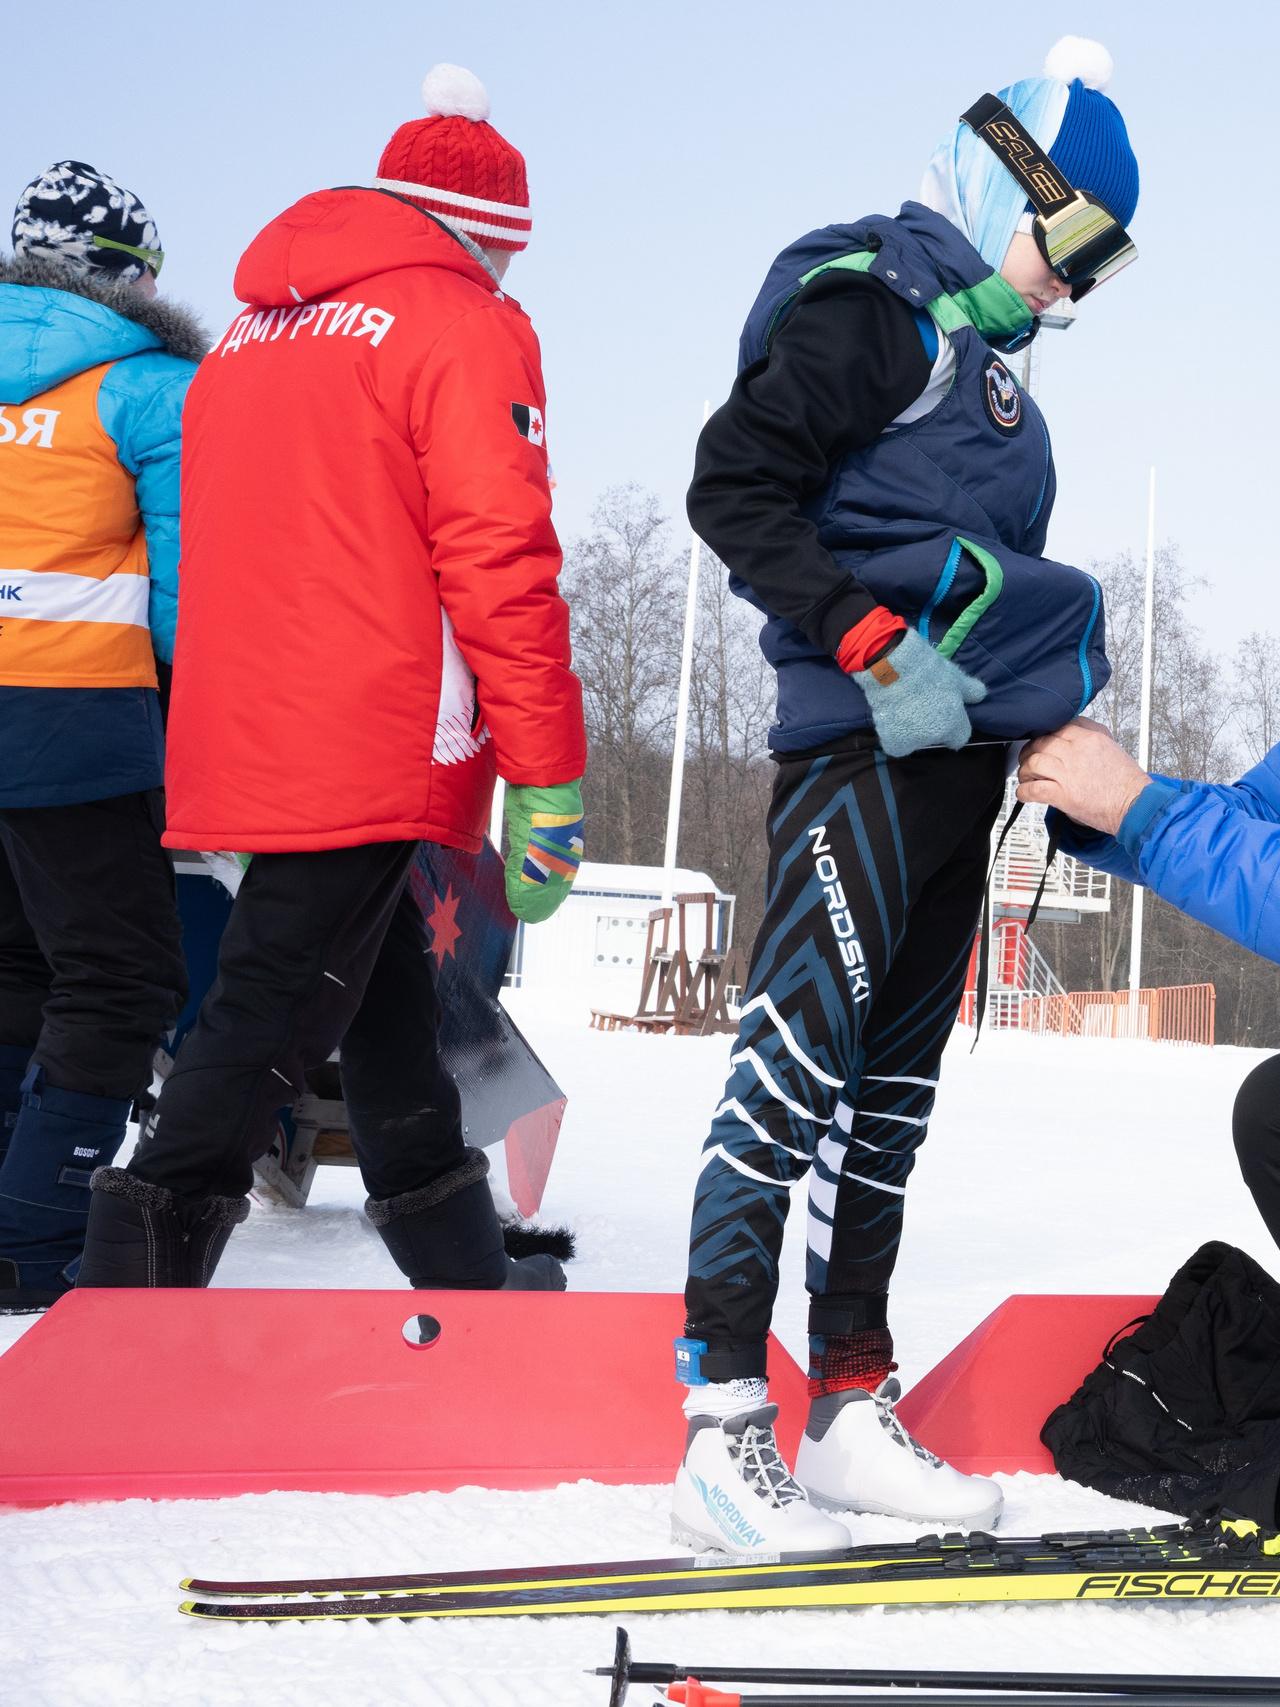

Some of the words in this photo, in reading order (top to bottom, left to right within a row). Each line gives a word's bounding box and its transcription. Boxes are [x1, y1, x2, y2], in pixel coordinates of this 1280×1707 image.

[986, 121, 1067, 204] SALICE
[808, 825, 870, 1004] NORDSKI
[709, 1484, 766, 1547] NORDWAY
